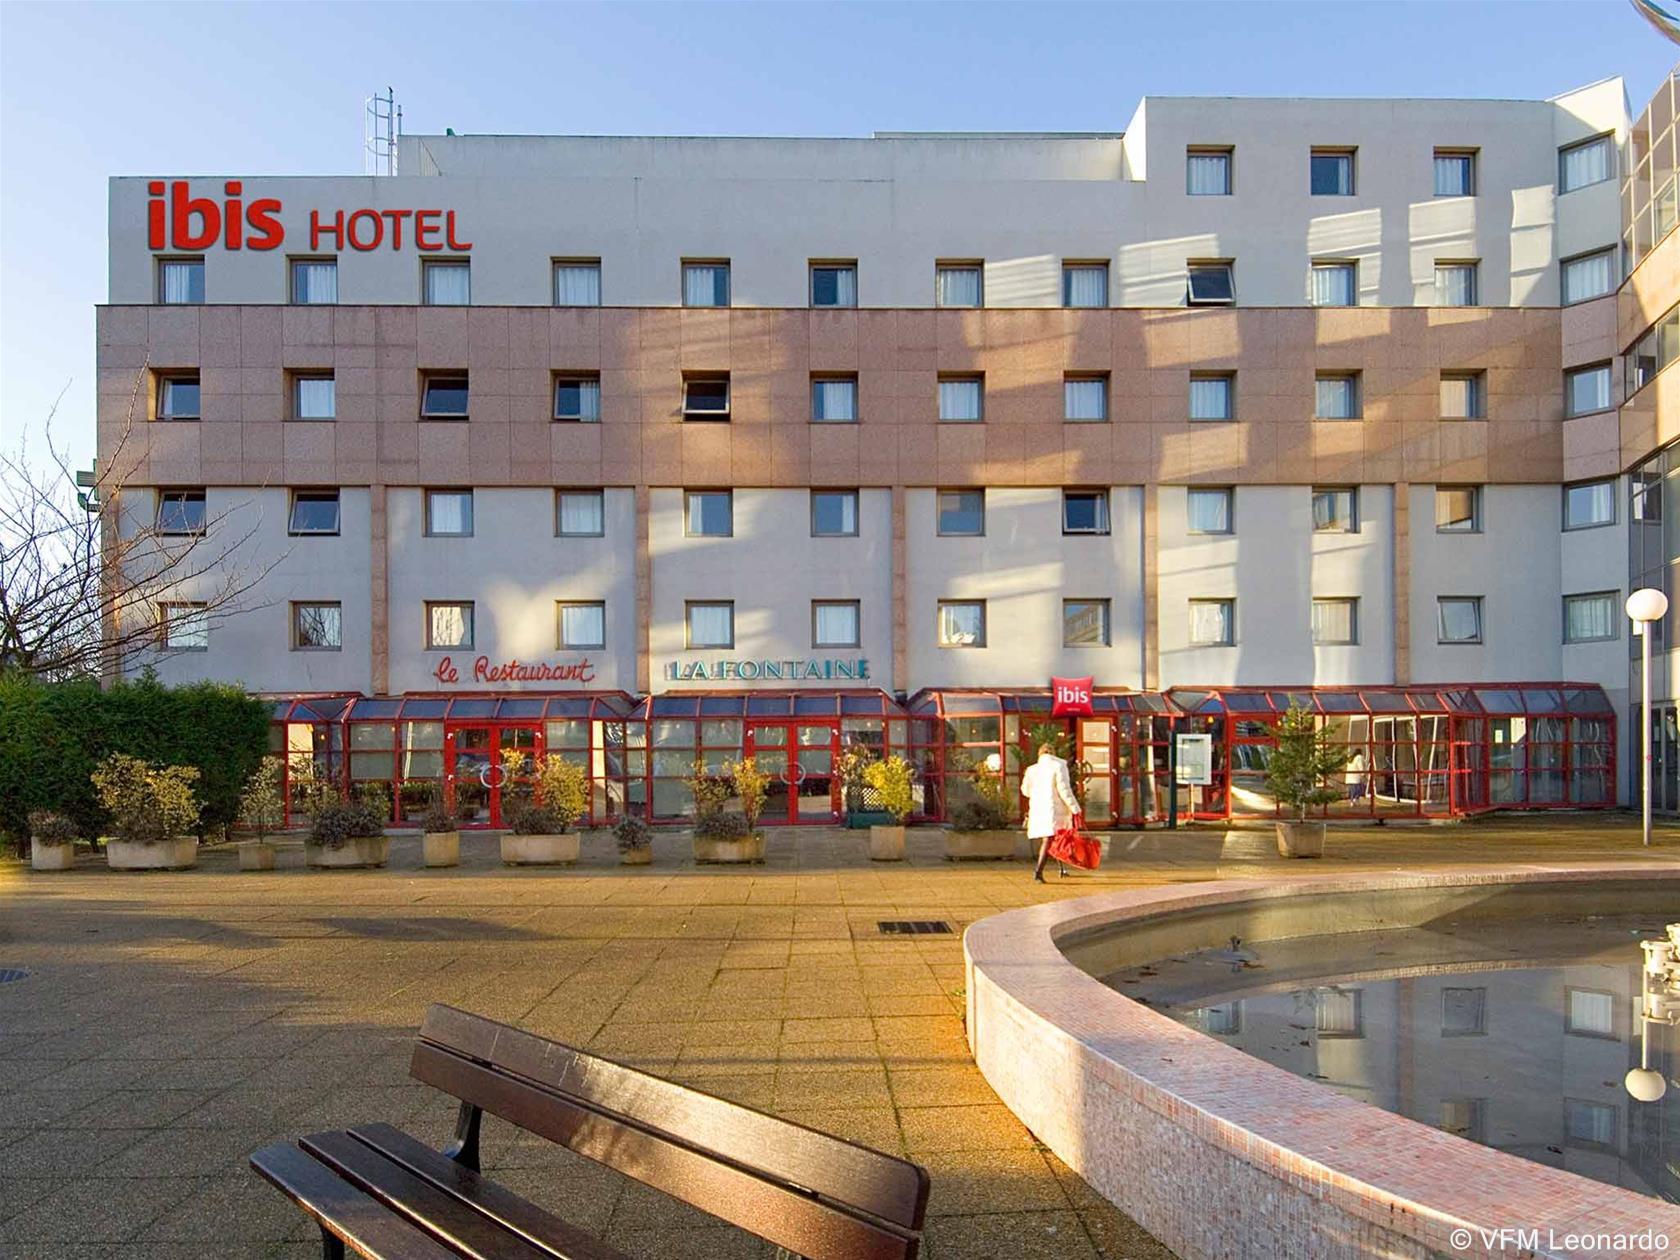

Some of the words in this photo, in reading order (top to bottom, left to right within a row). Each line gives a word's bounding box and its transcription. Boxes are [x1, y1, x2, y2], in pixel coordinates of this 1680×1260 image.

[148, 181, 284, 251] ibis
[310, 209, 472, 252] HOTEL
[433, 656, 459, 684] le
[474, 656, 595, 684] Restaurant
[672, 659, 711, 680] LA
[720, 659, 869, 680] FONTAINE
[1057, 686, 1089, 704] ibis
